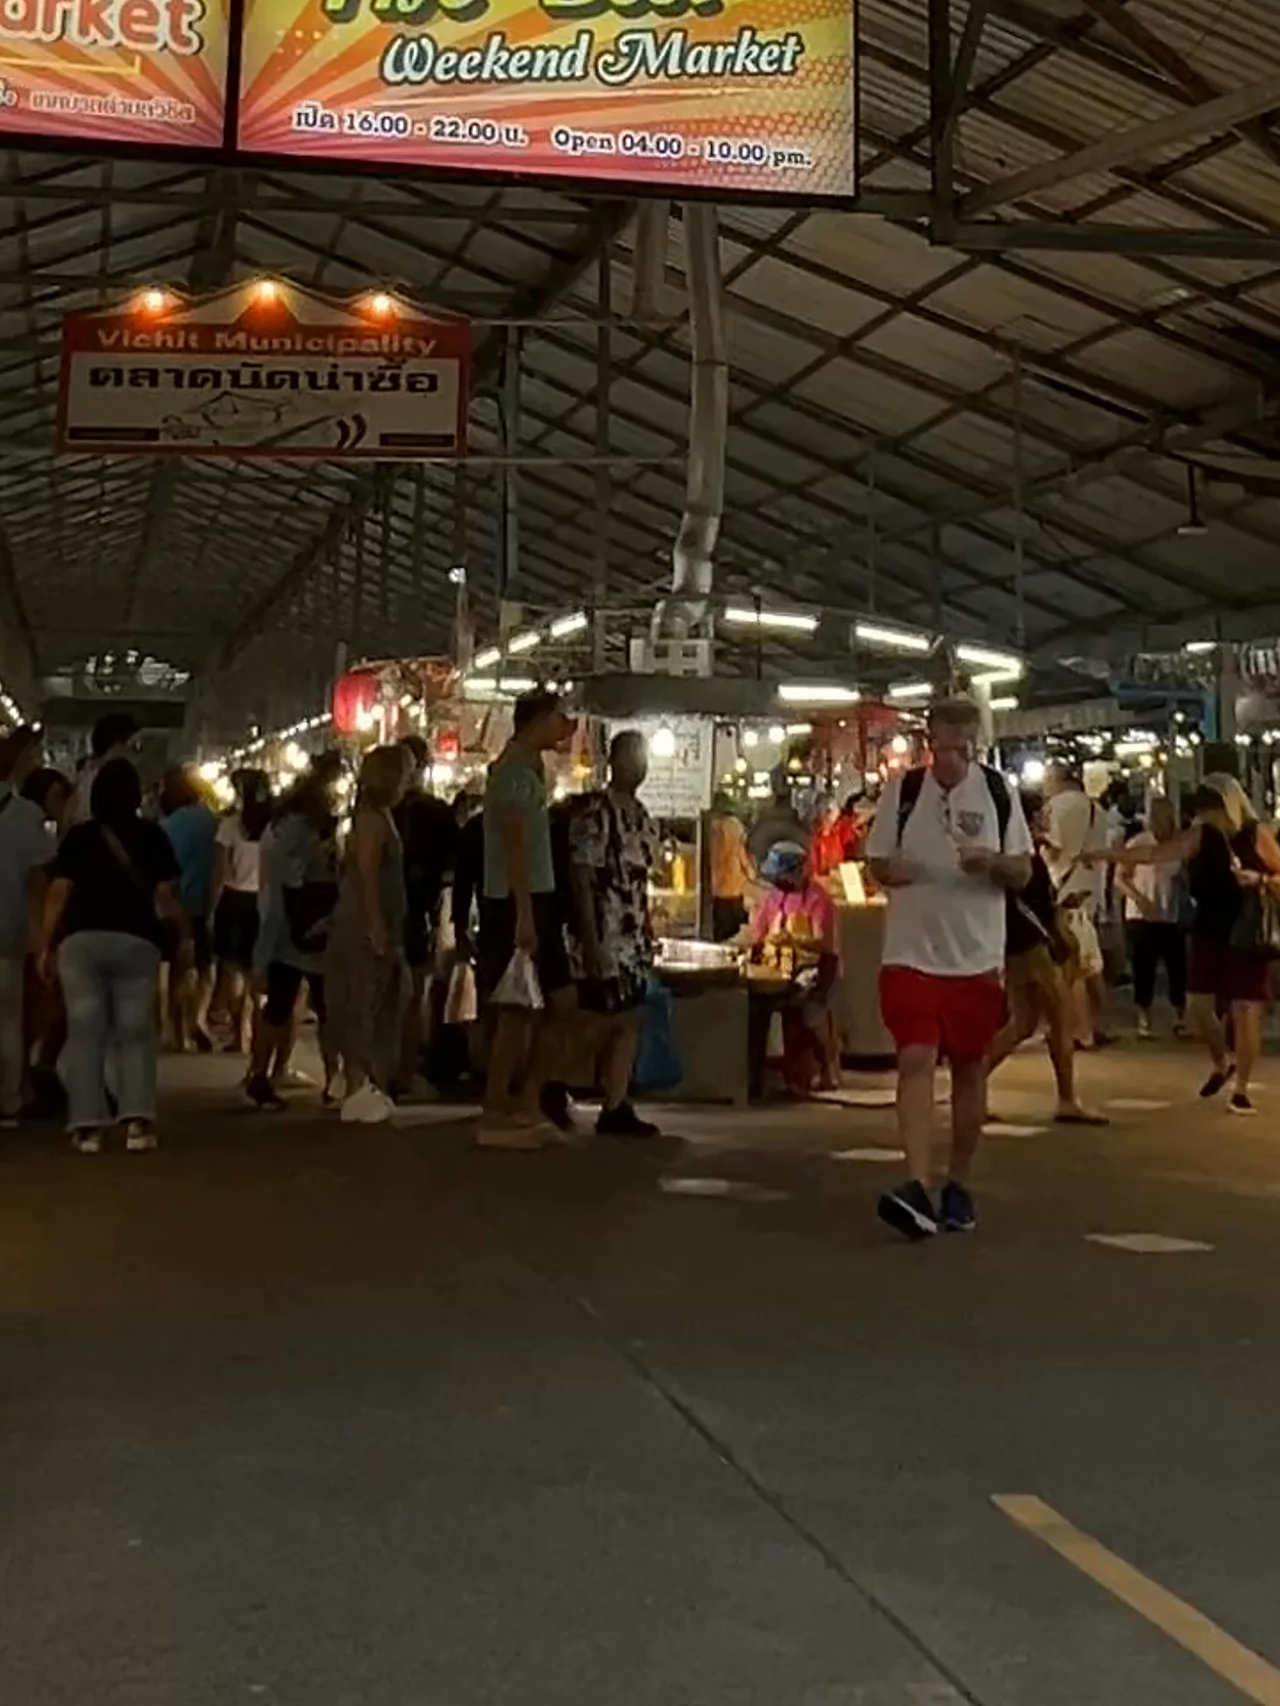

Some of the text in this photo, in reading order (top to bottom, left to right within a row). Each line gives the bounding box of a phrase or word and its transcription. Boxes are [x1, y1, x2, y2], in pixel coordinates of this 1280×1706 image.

[380, 25, 803, 86] Weekend Market
[293, 105, 336, 135] เปิด
[346, 112, 409, 137] 16.00
[432, 118, 497, 144] 22.00
[553, 127, 614, 154] Open
[621, 133, 682, 158] 04.00
[706, 139, 766, 164] 10.00
[771, 148, 813, 170] pm.
[96, 328, 438, 357] Vichit Municipality
[89, 355, 440, 394] ตลาดนัดน่าซื้อ
